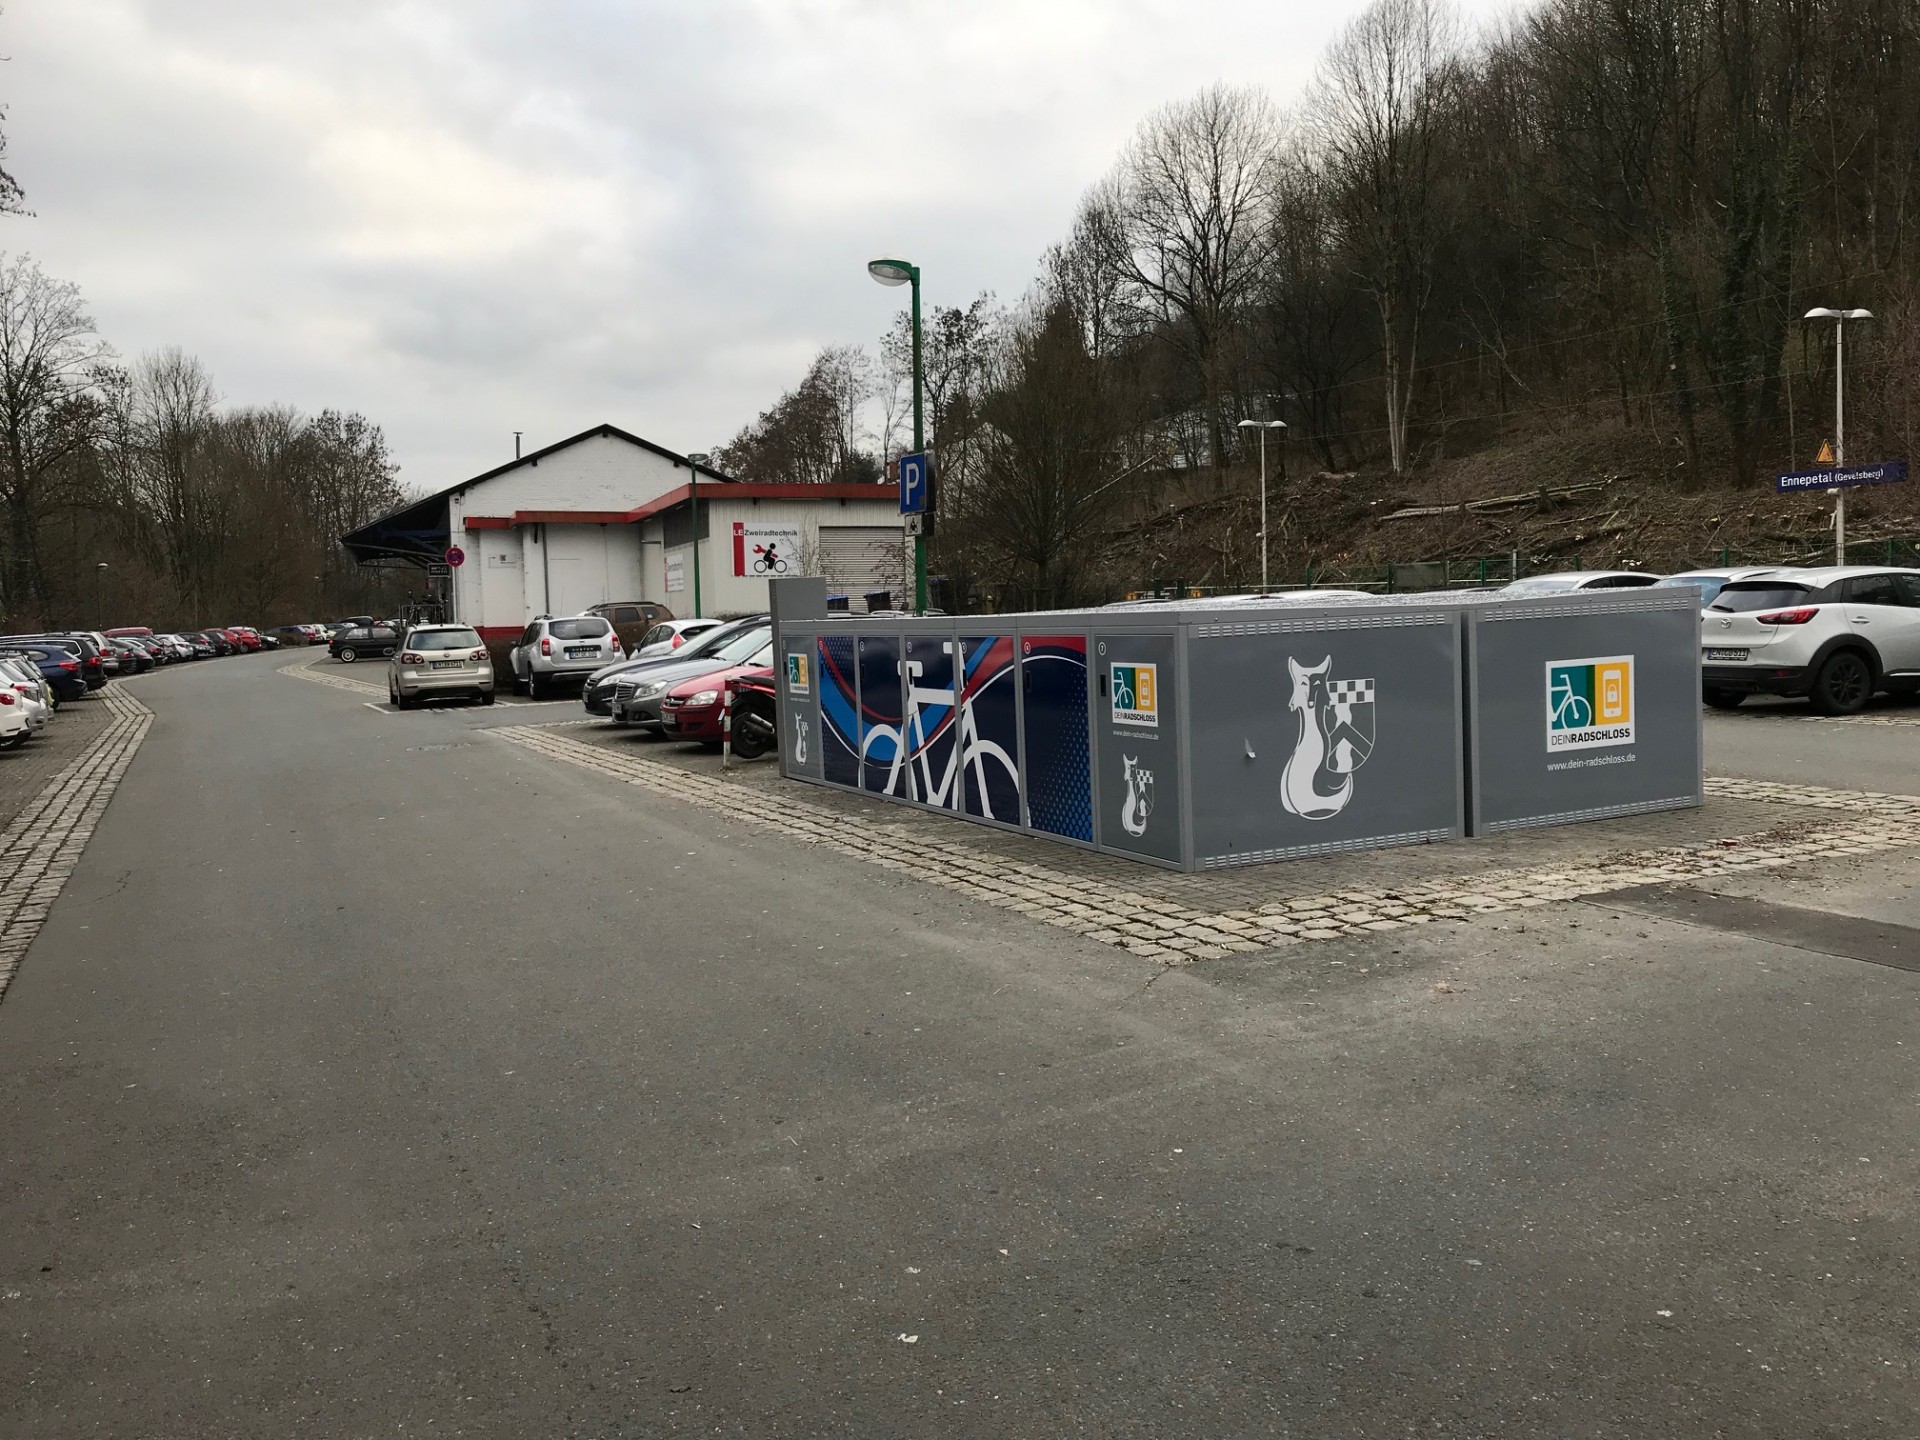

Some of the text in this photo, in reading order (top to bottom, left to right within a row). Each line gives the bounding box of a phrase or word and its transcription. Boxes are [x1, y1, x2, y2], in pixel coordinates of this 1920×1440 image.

[906, 462, 920, 505] P
[1781, 472, 1832, 487] Ennepetal
[1114, 711, 1156, 723] DEINRADSCHLOSS
[1551, 728, 1631, 746] DEINRADSCHLOSS
[1547, 753, 1636, 771] www.dein-radschloss.de
